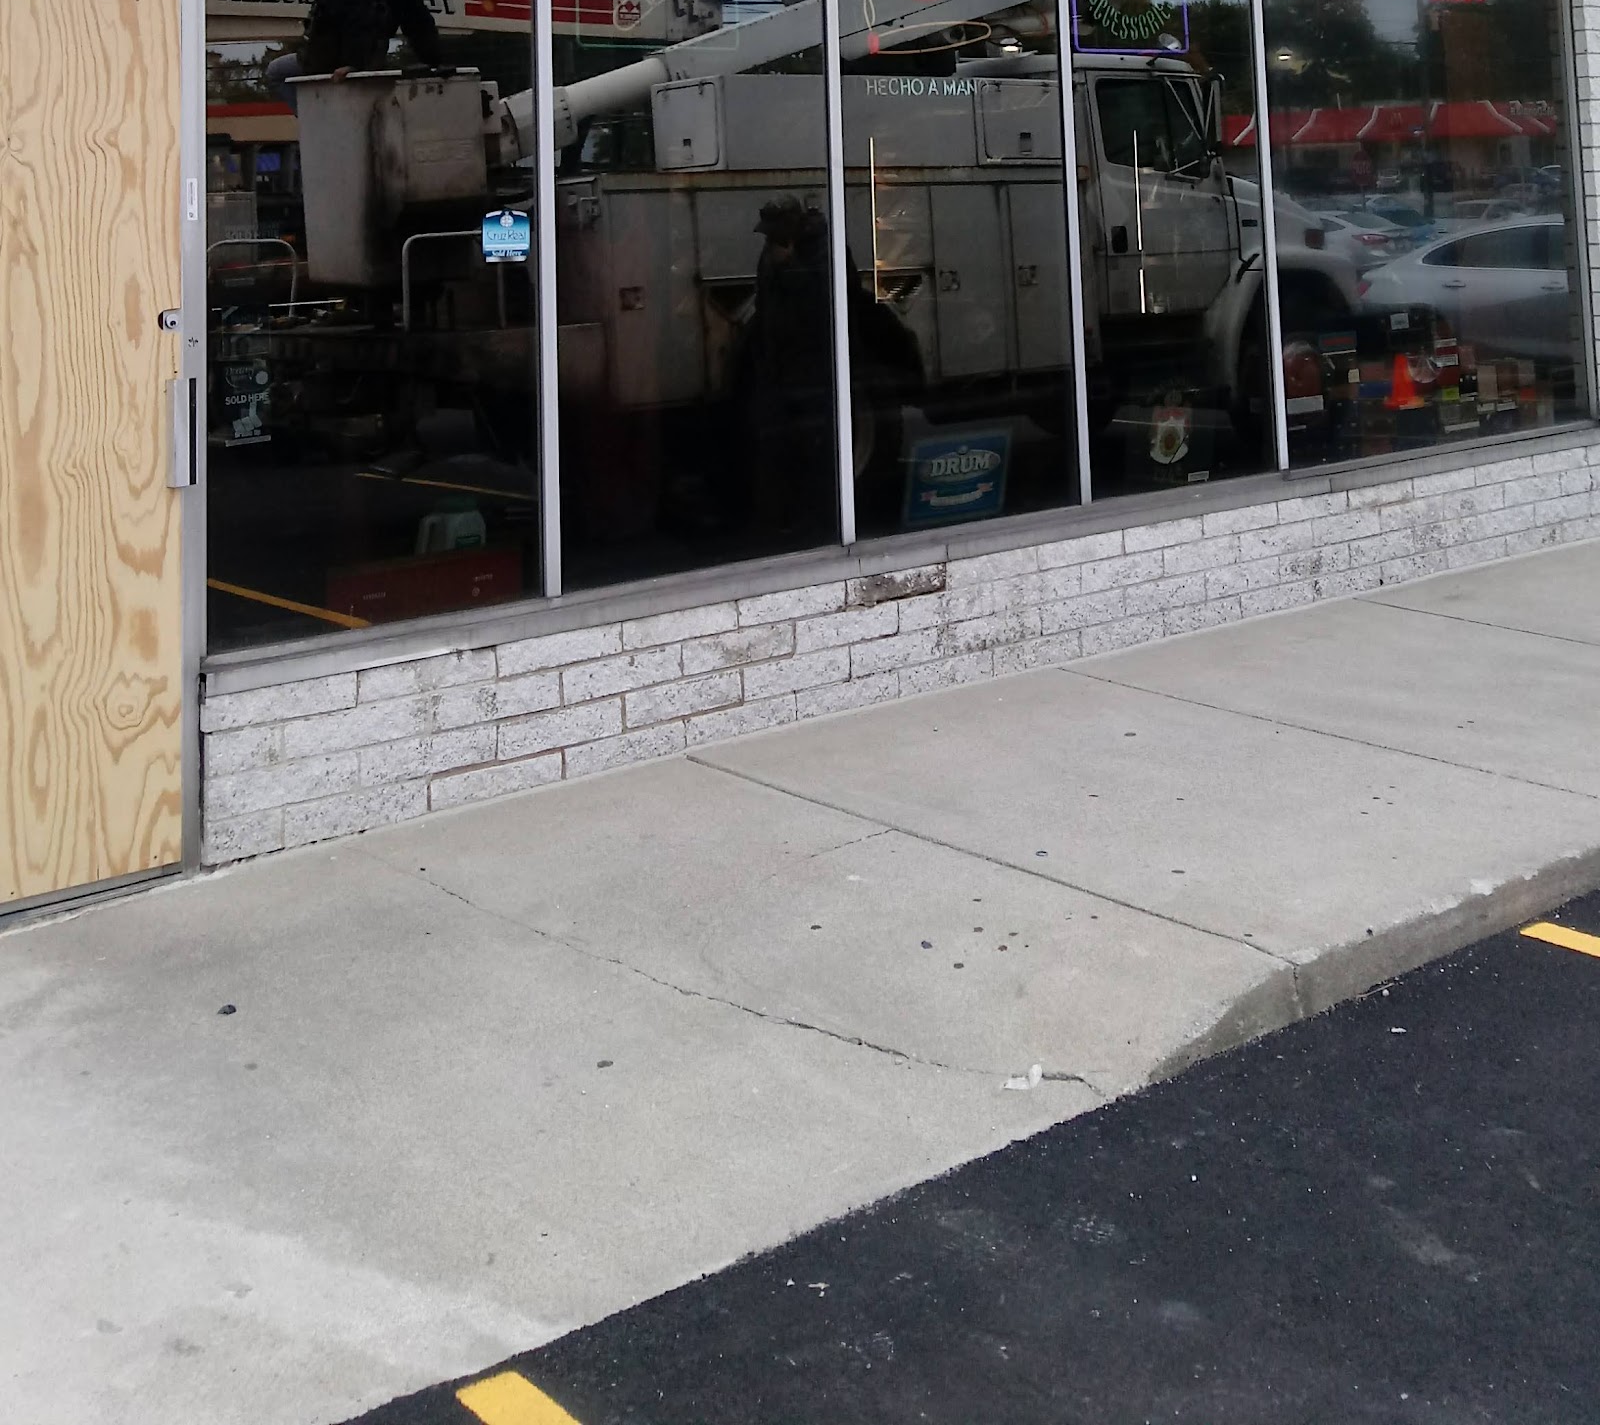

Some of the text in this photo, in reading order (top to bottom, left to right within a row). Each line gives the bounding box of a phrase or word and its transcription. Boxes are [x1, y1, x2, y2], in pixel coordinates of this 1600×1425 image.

[865, 77, 925, 97] HECHO
[224, 394, 247, 406] SOLD
[928, 452, 992, 478] DRUM
